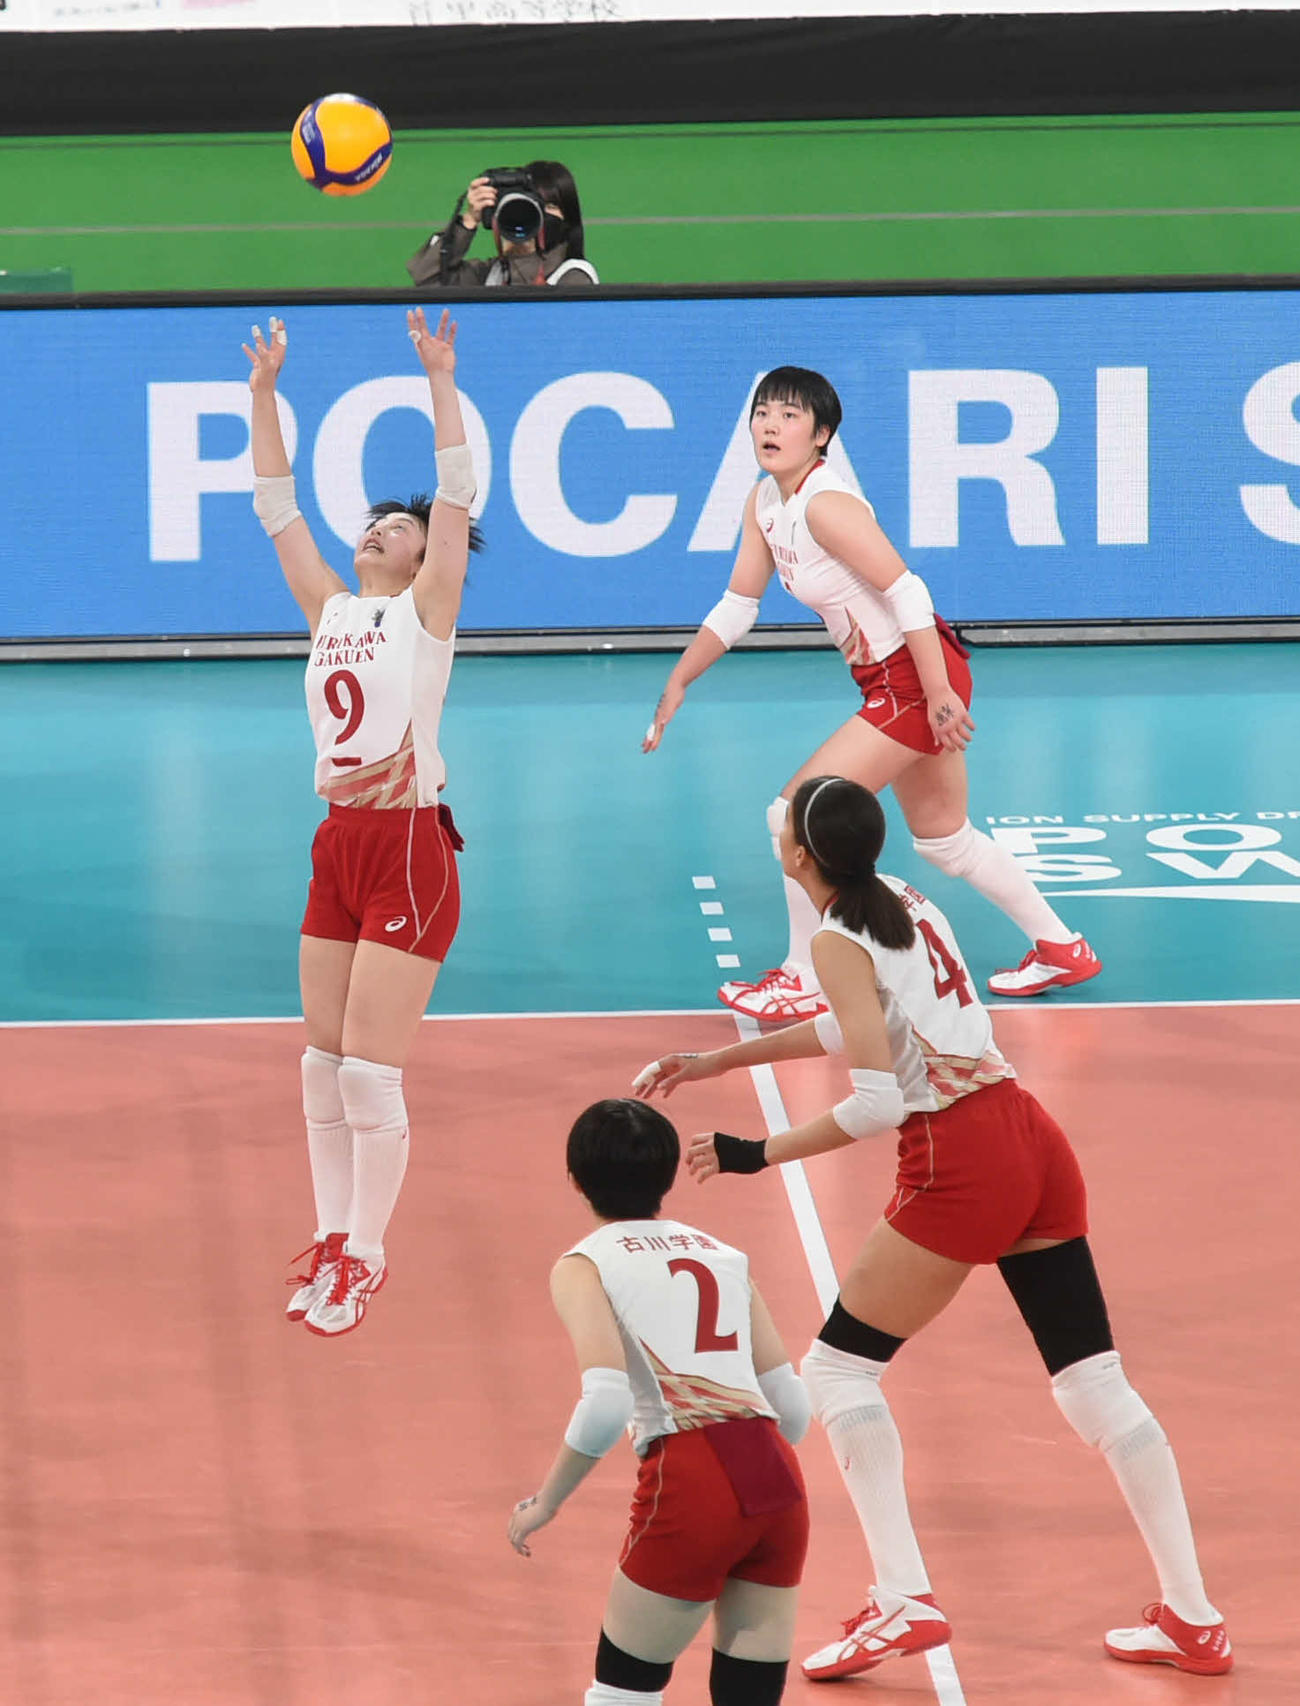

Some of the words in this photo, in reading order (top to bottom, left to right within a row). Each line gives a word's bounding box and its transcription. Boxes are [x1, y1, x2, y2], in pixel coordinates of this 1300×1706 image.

[324, 670, 364, 745] 9
[986, 815, 1064, 825] ION
[1083, 812, 1240, 824] SUPPLY
[915, 918, 974, 1009] 4
[667, 1258, 738, 1353] 2
